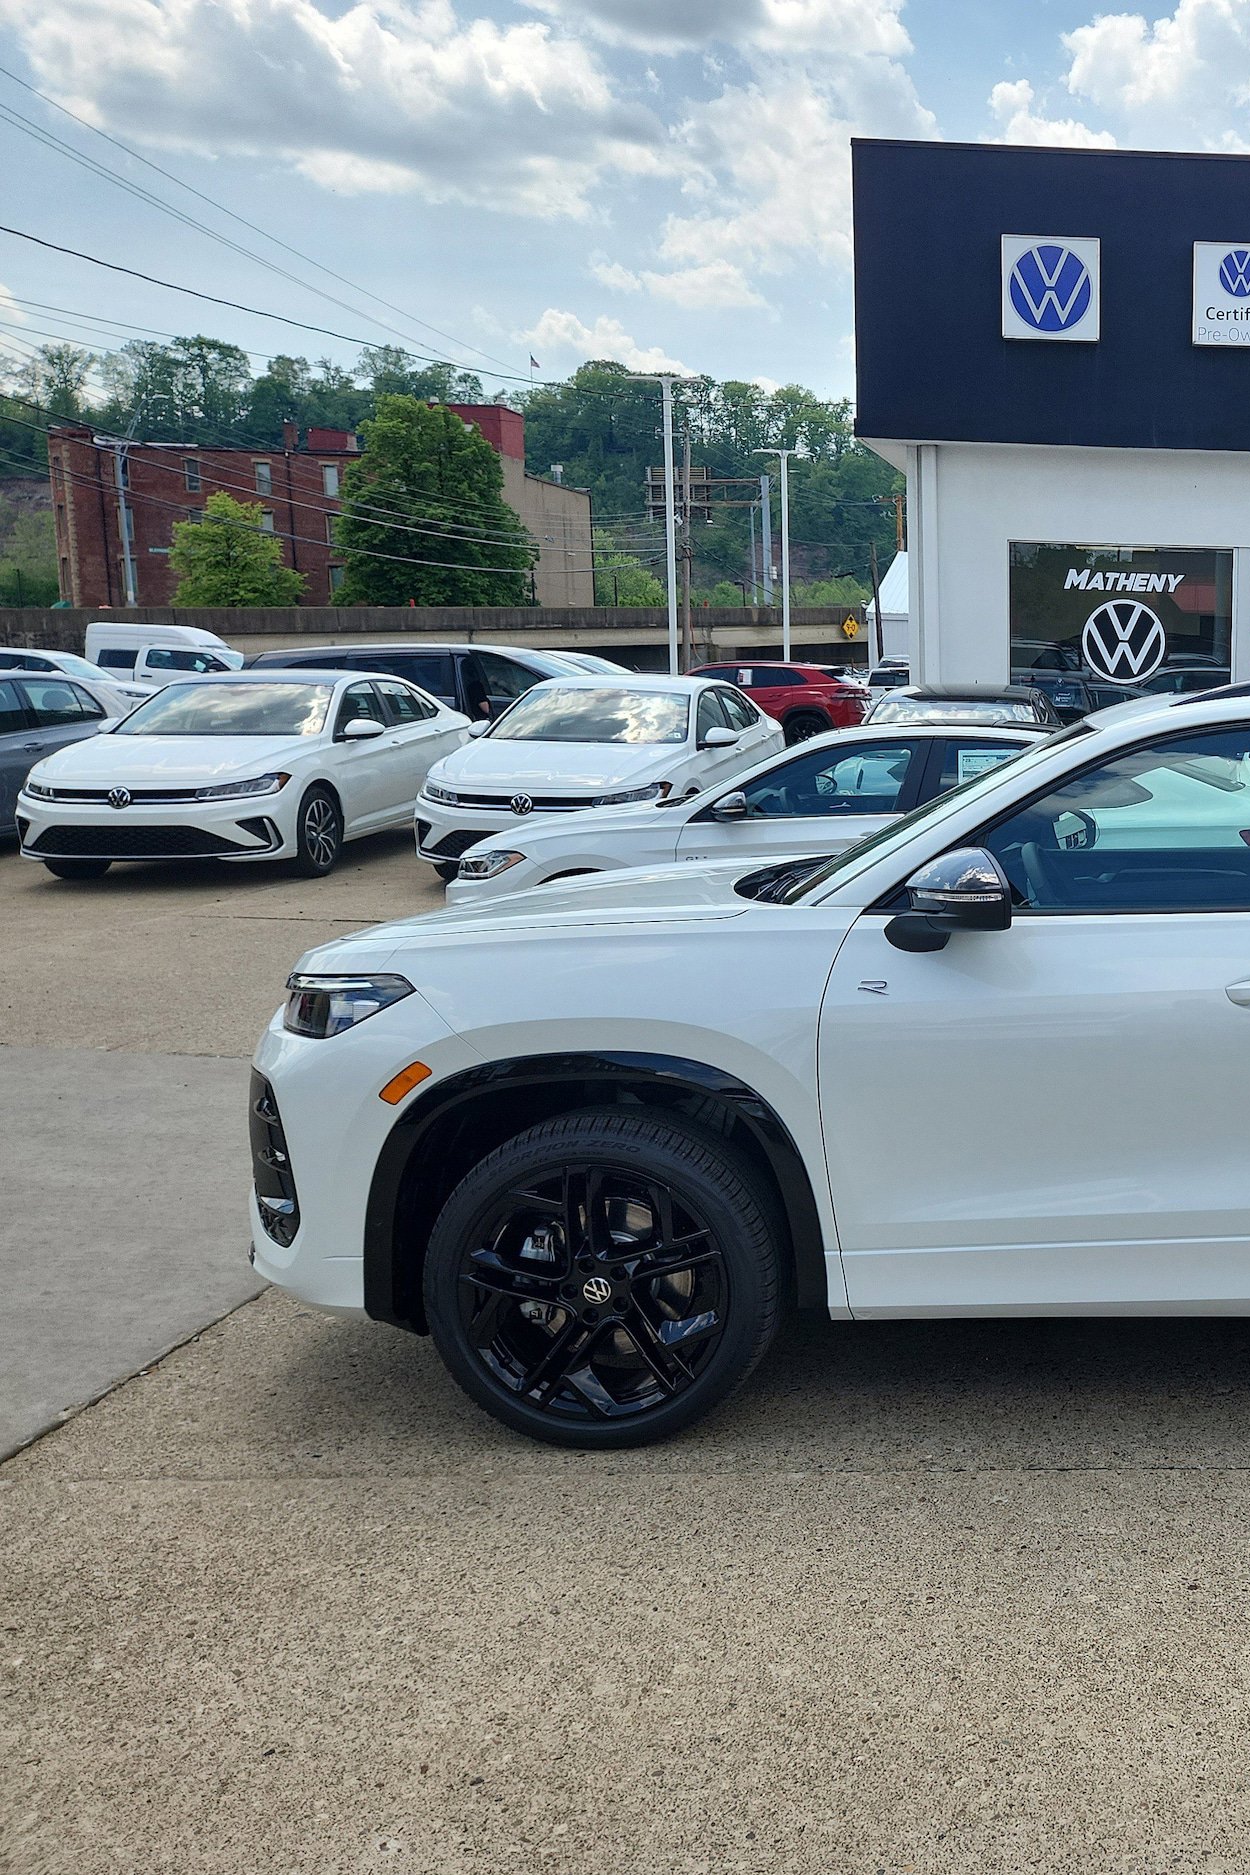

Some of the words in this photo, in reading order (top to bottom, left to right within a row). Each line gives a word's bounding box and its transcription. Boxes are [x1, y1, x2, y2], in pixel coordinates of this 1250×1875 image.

[1064, 568, 1186, 592] MATHENY
[488, 1140, 580, 1182] SCORPION
[586, 1139, 641, 1153] ZERO
